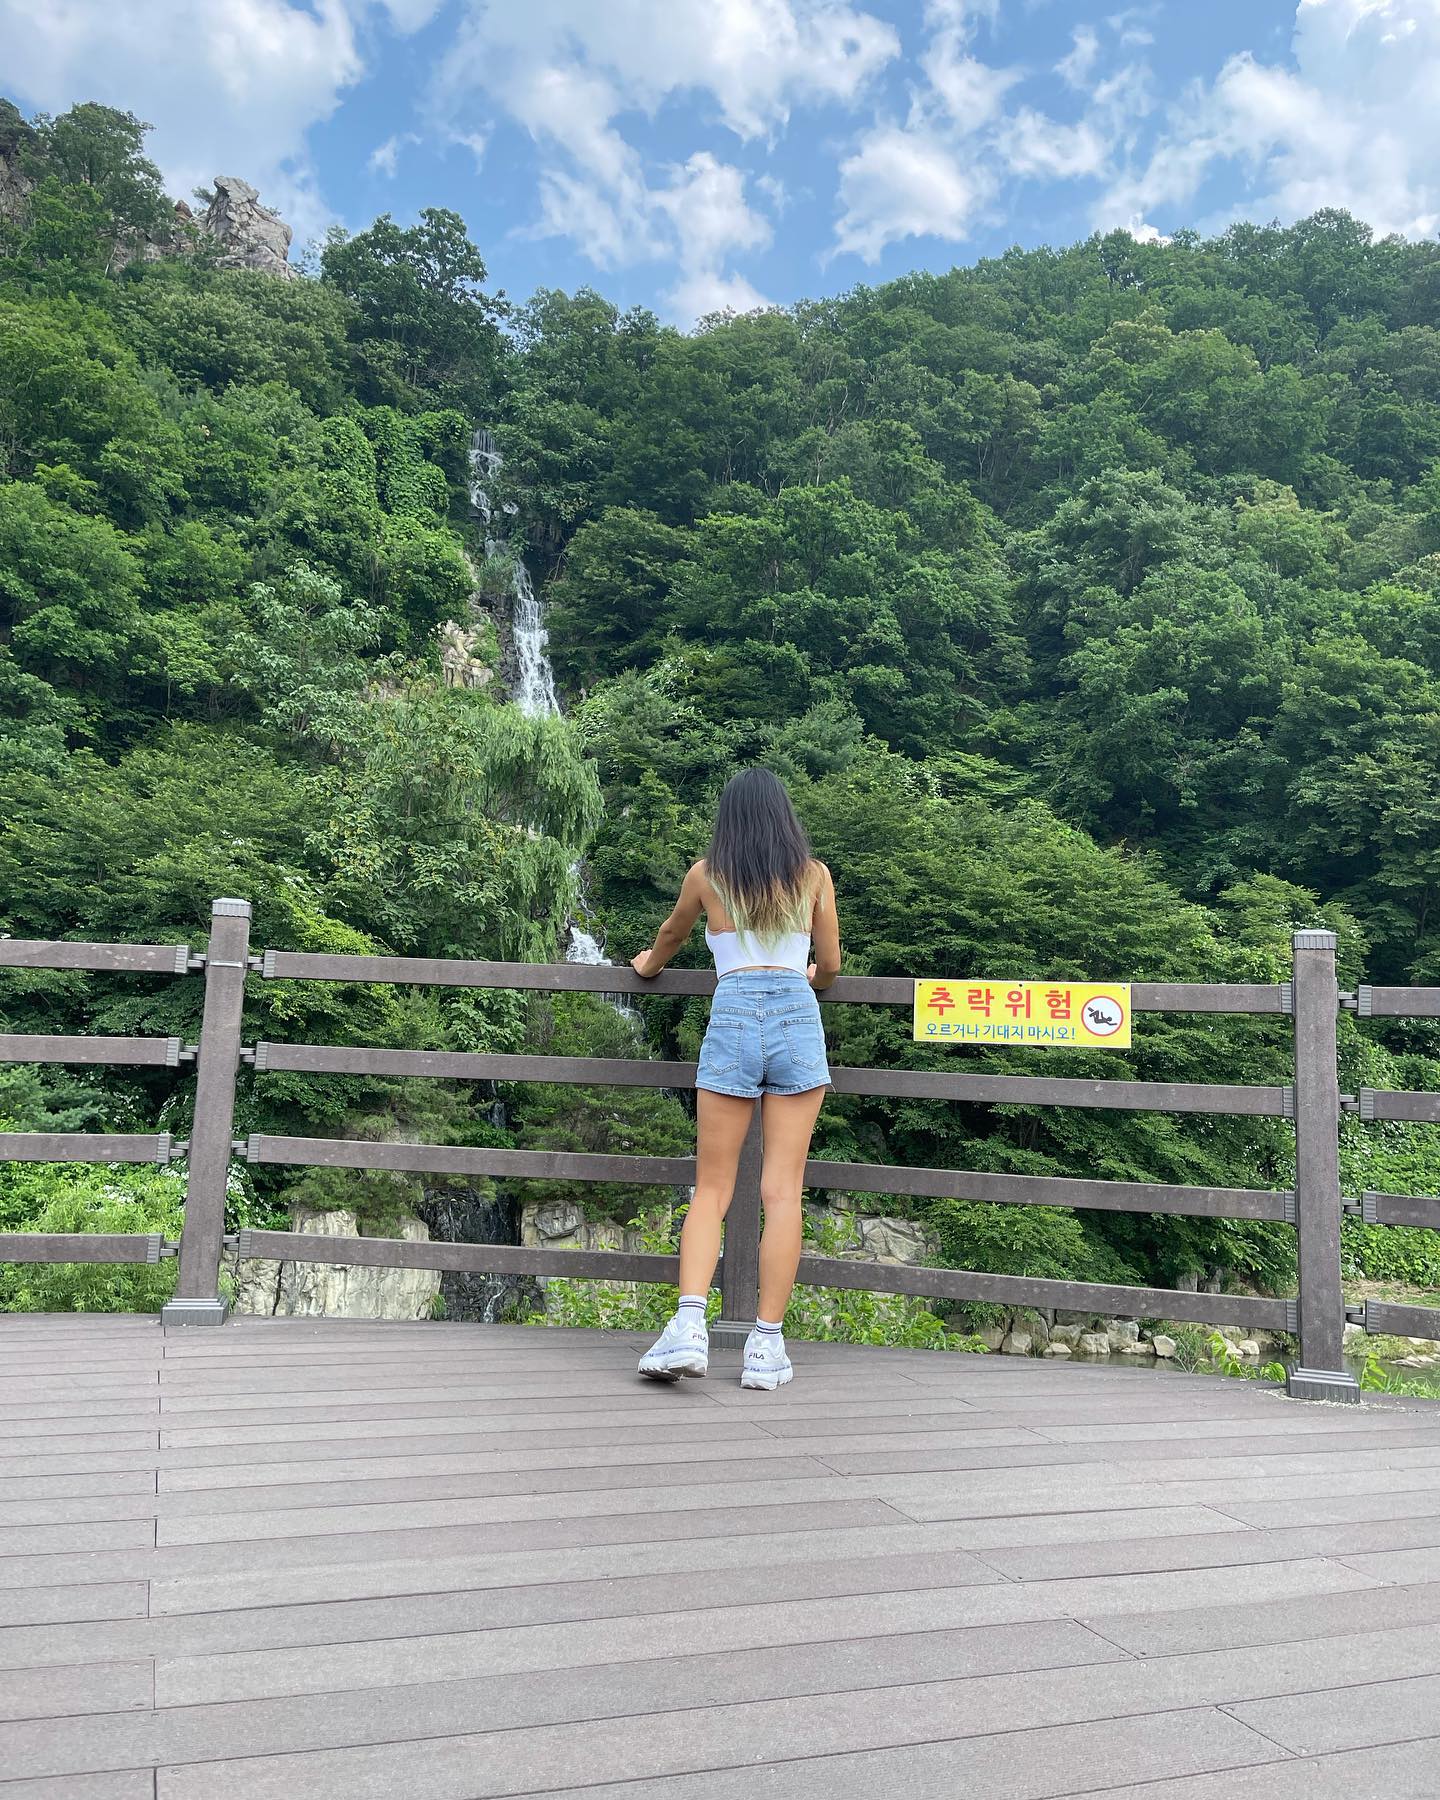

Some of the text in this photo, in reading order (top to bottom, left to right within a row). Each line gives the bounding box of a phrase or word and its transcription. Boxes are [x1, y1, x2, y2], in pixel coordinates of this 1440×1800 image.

[925, 1023, 1075, 1040] 오르거나 기대지 마시오!
[748, 1352, 765, 1360] FILA
